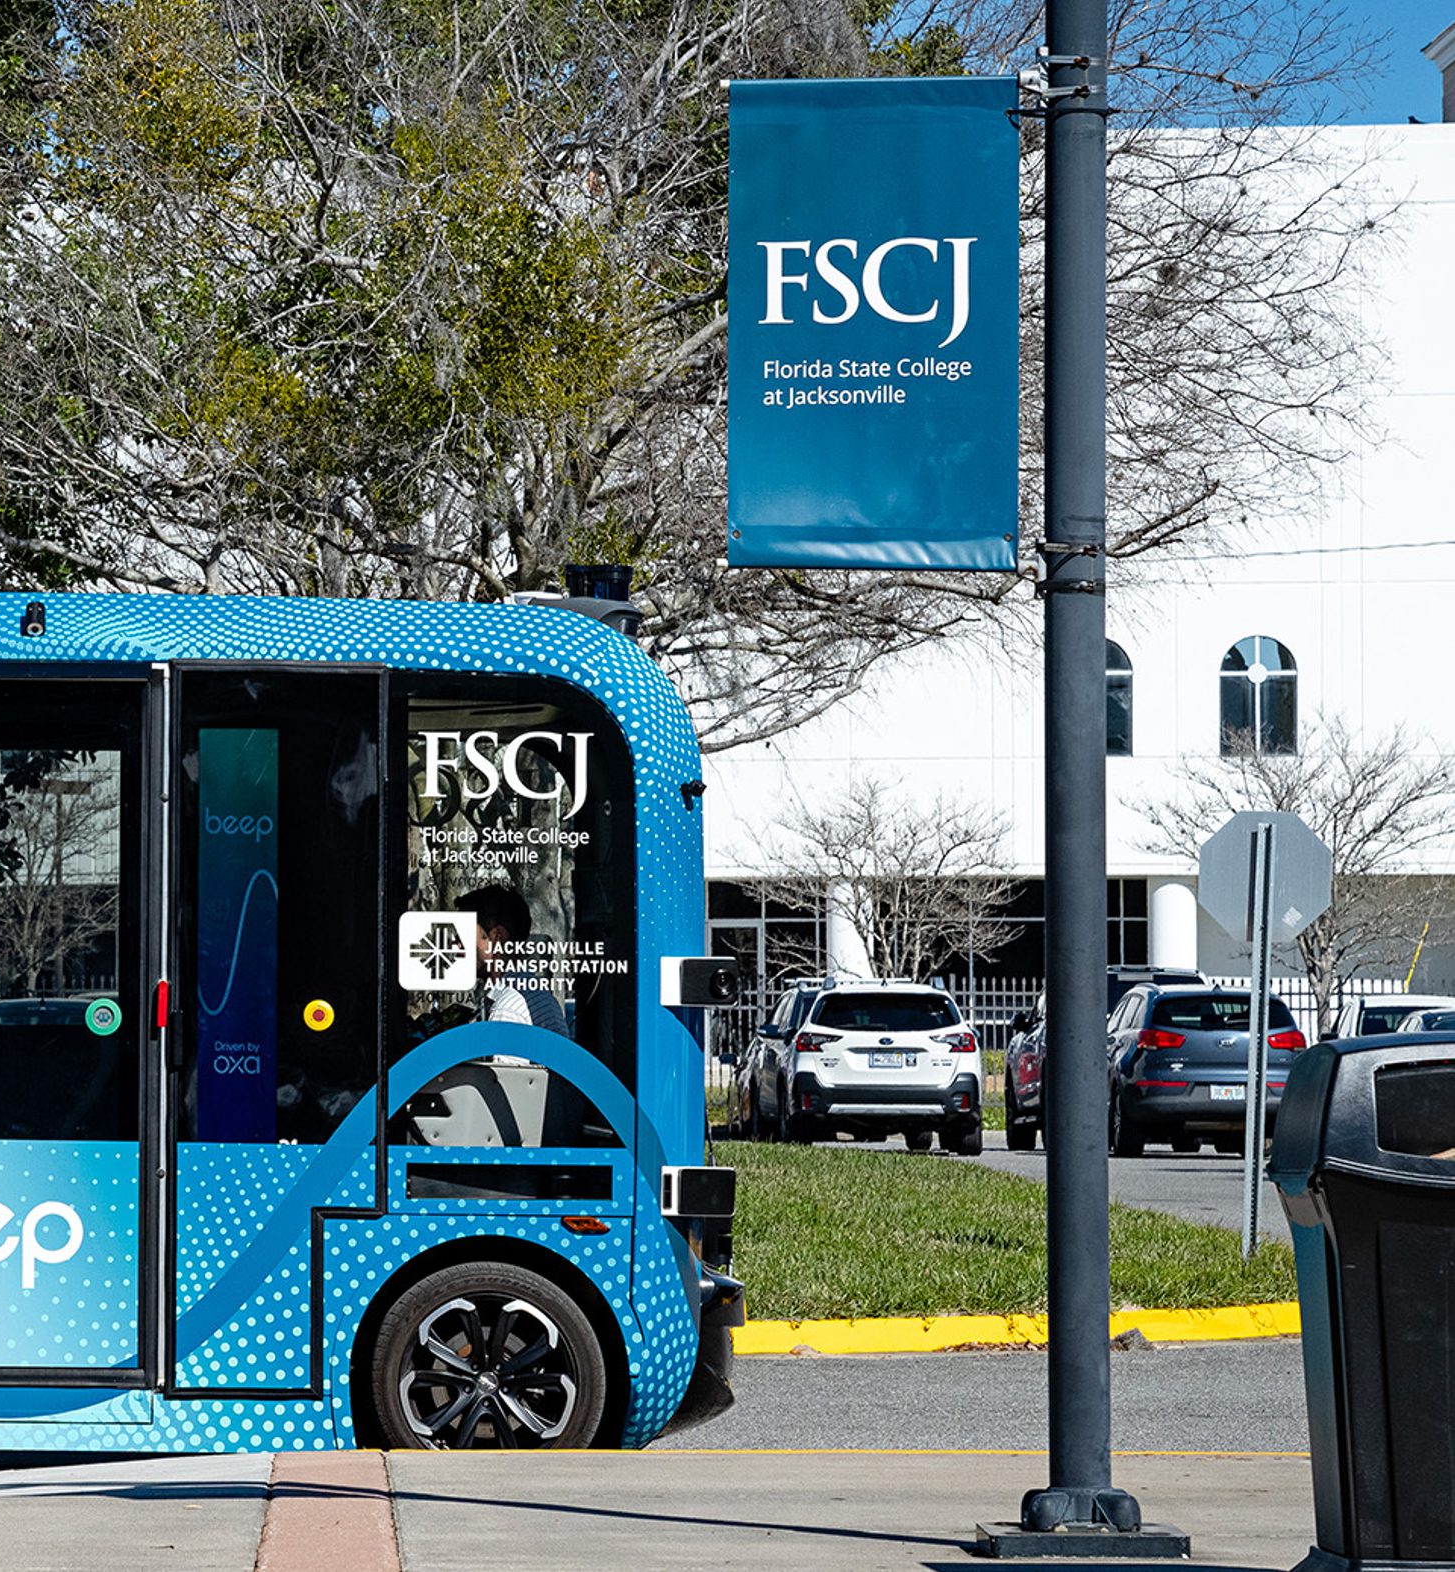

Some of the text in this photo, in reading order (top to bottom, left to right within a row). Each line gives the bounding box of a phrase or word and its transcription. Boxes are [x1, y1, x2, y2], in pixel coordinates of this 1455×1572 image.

[757, 237, 978, 348] FSCJ
[763, 357, 972, 379] Florida State College
[763, 385, 906, 409] at Jacksonville
[418, 731, 594, 821] FSCJ
[205, 806, 274, 843] beep
[422, 827, 590, 848] Florida State College
[422, 848, 539, 864] at Jacksonville
[483, 941, 605, 955] JACKSONVILLE
[484, 959, 629, 974] TRANSPORTATION
[483, 977, 576, 991] AUTHORITY
[214, 1040, 261, 1054] Driven by
[213, 1055, 261, 1075] oxa
